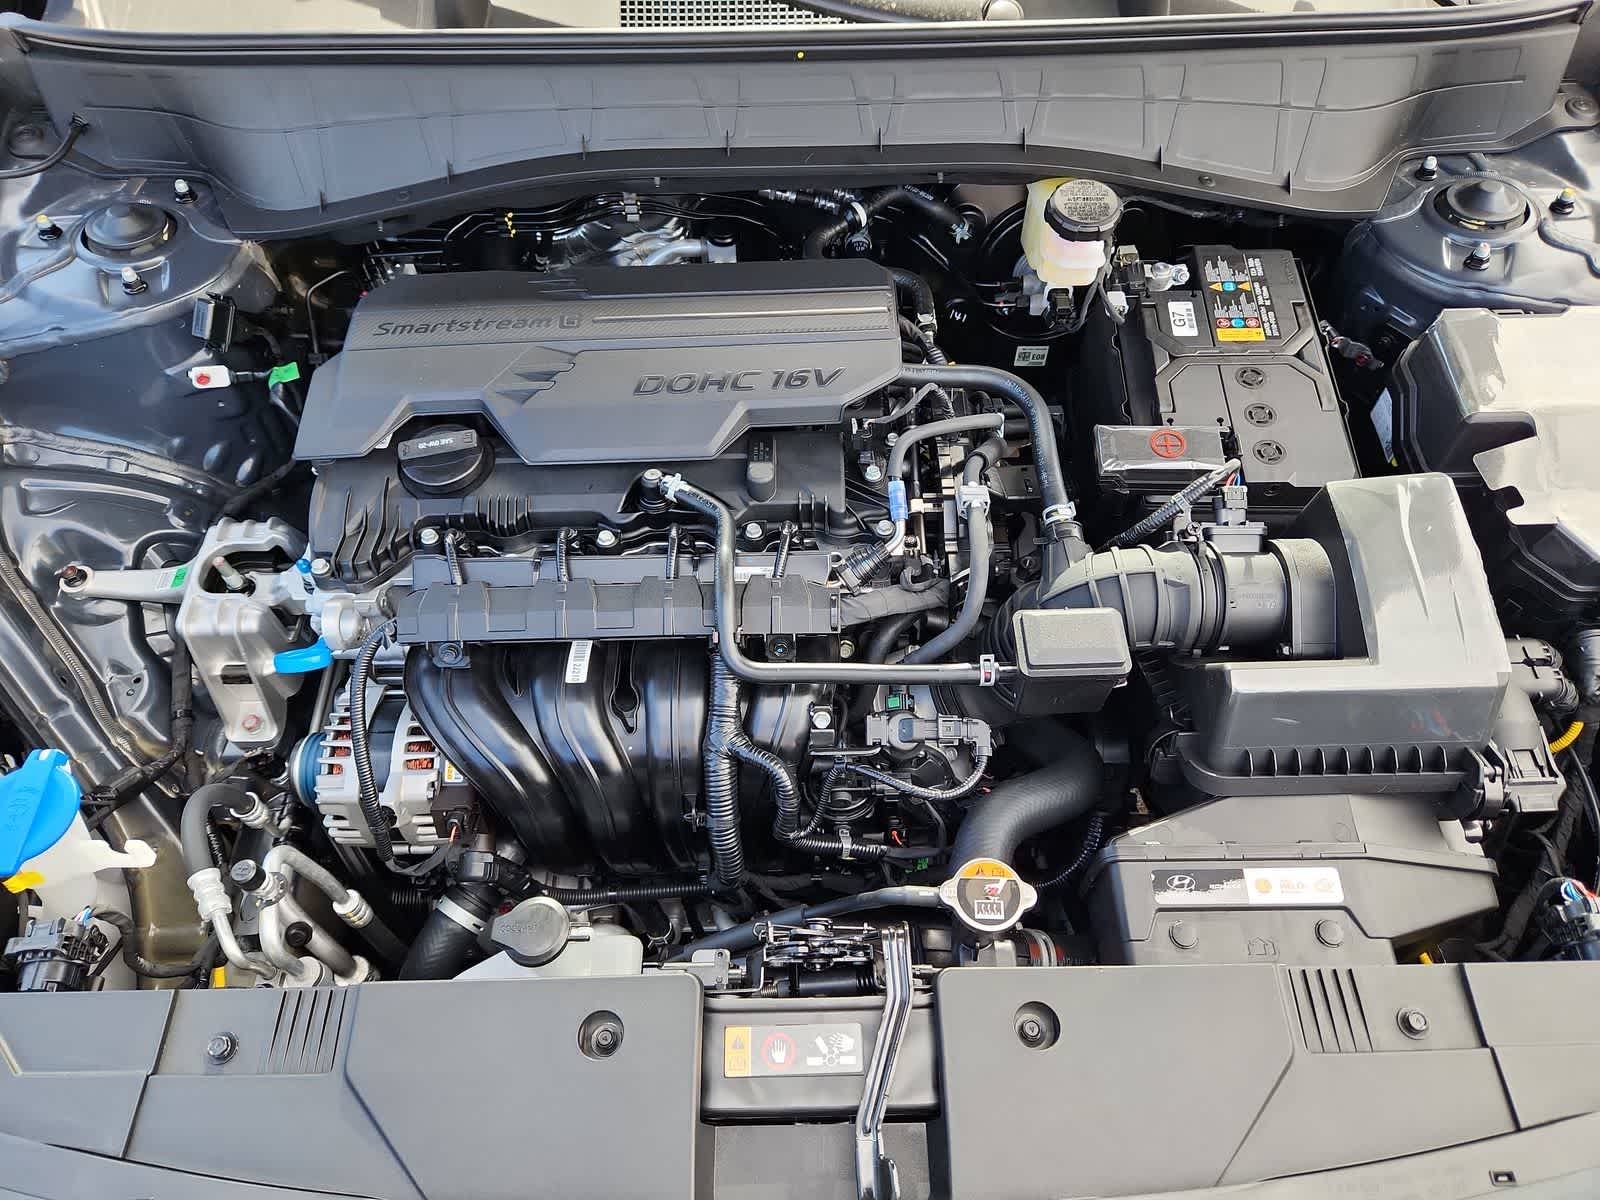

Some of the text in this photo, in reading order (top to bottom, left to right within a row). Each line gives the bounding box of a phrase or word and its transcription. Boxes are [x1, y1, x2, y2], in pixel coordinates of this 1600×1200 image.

[949, 309, 967, 323] 141
[1171, 311, 1187, 327] G7
[372, 316, 552, 336] Smartstream
[633, 366, 849, 396] DOHC 16V
